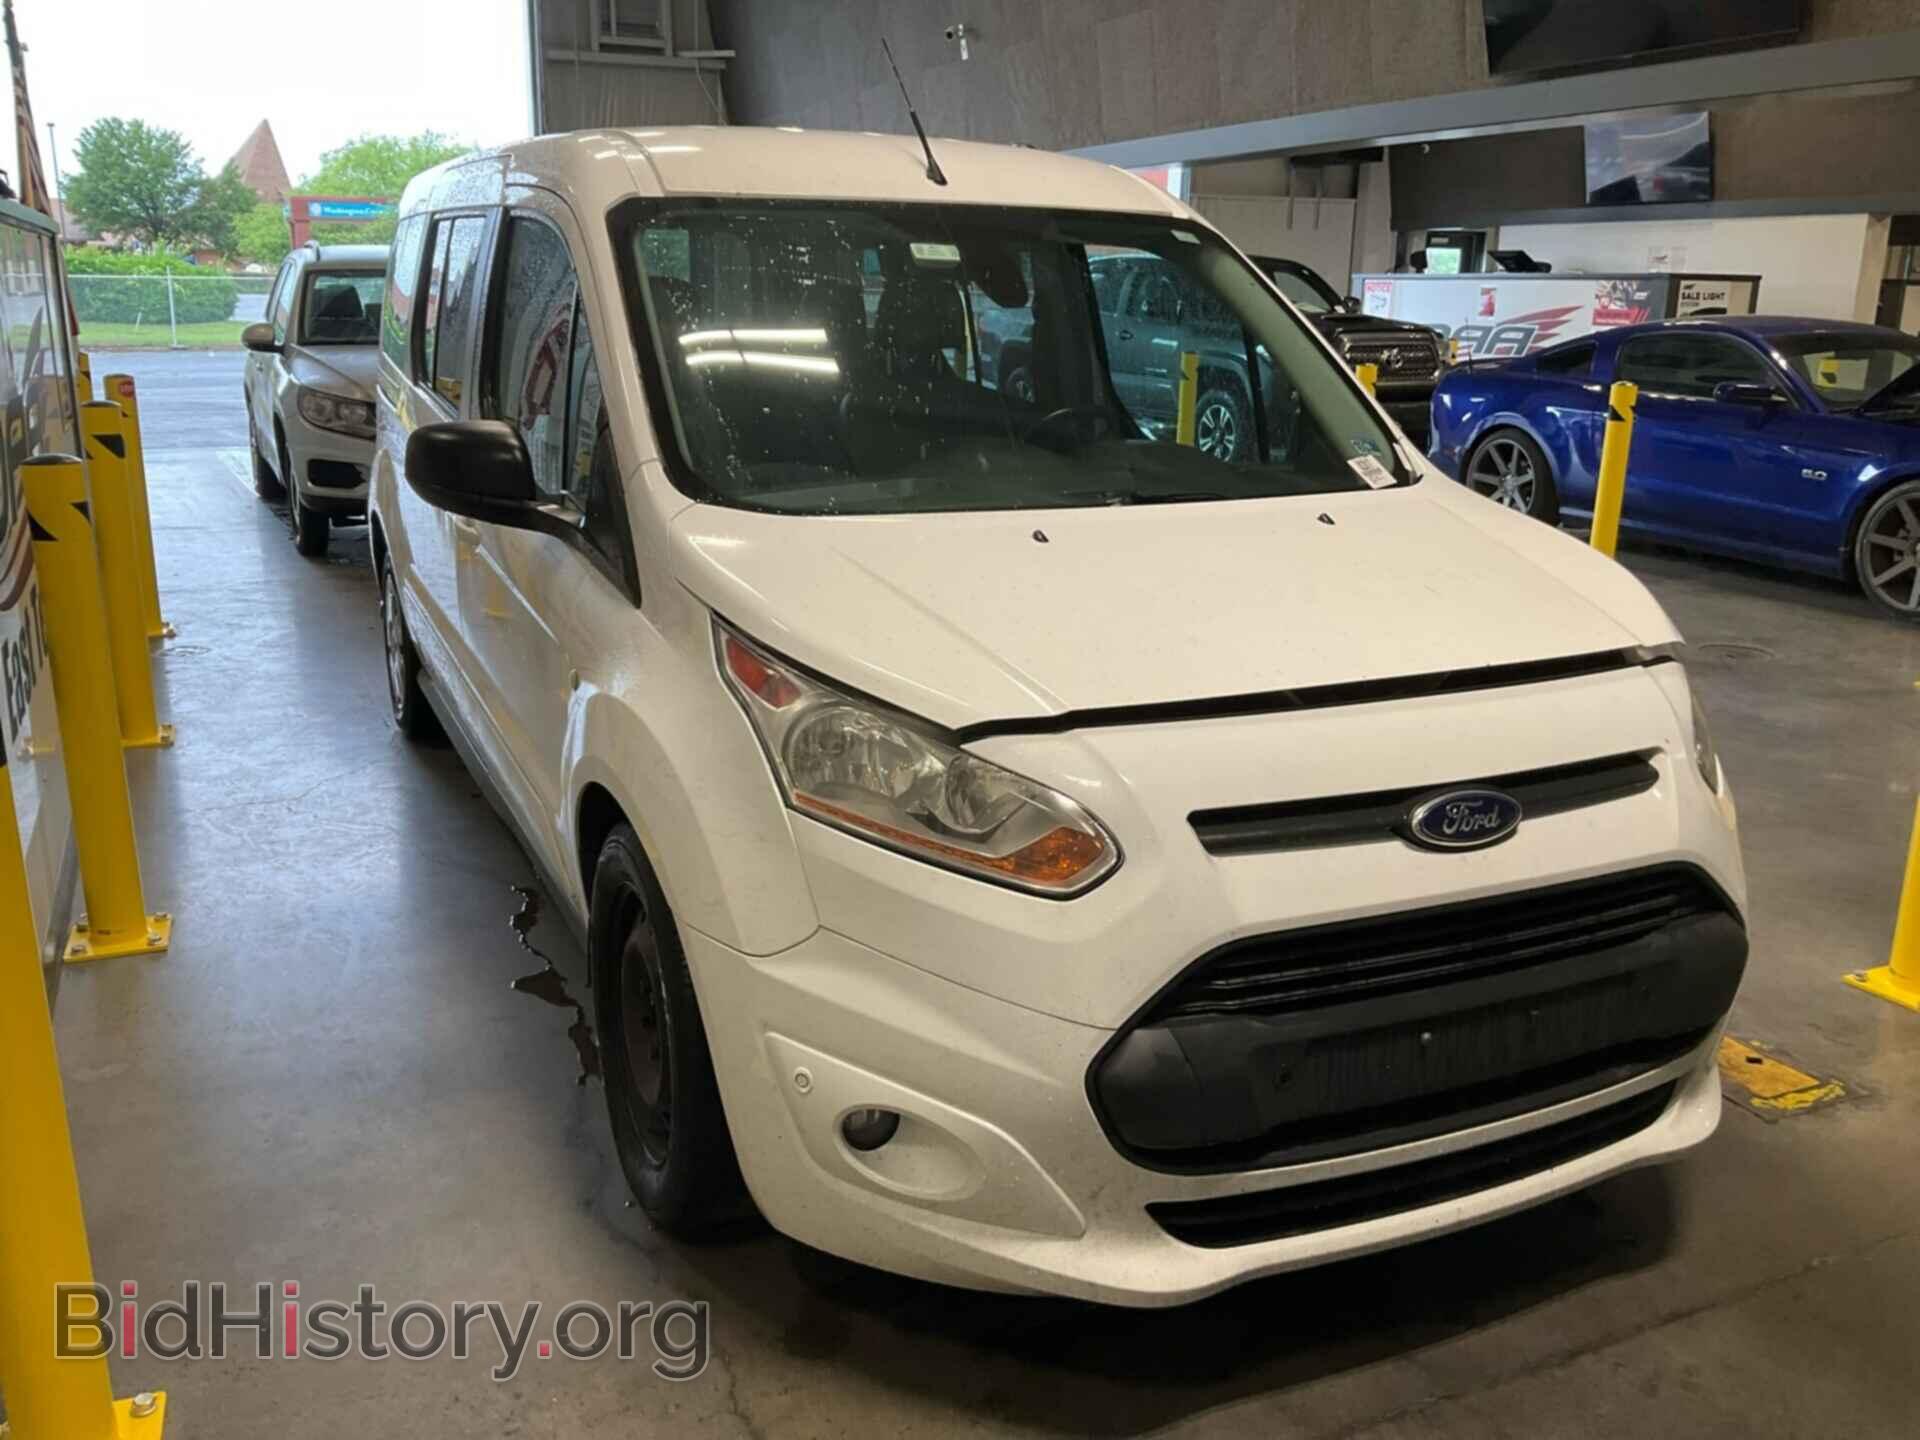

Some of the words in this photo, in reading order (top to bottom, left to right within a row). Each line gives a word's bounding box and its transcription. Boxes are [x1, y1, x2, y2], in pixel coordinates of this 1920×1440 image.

[1682, 292, 1700, 301] SALE
[1703, 292, 1725, 301] LIGHT
[1443, 801, 1500, 834] Ford
